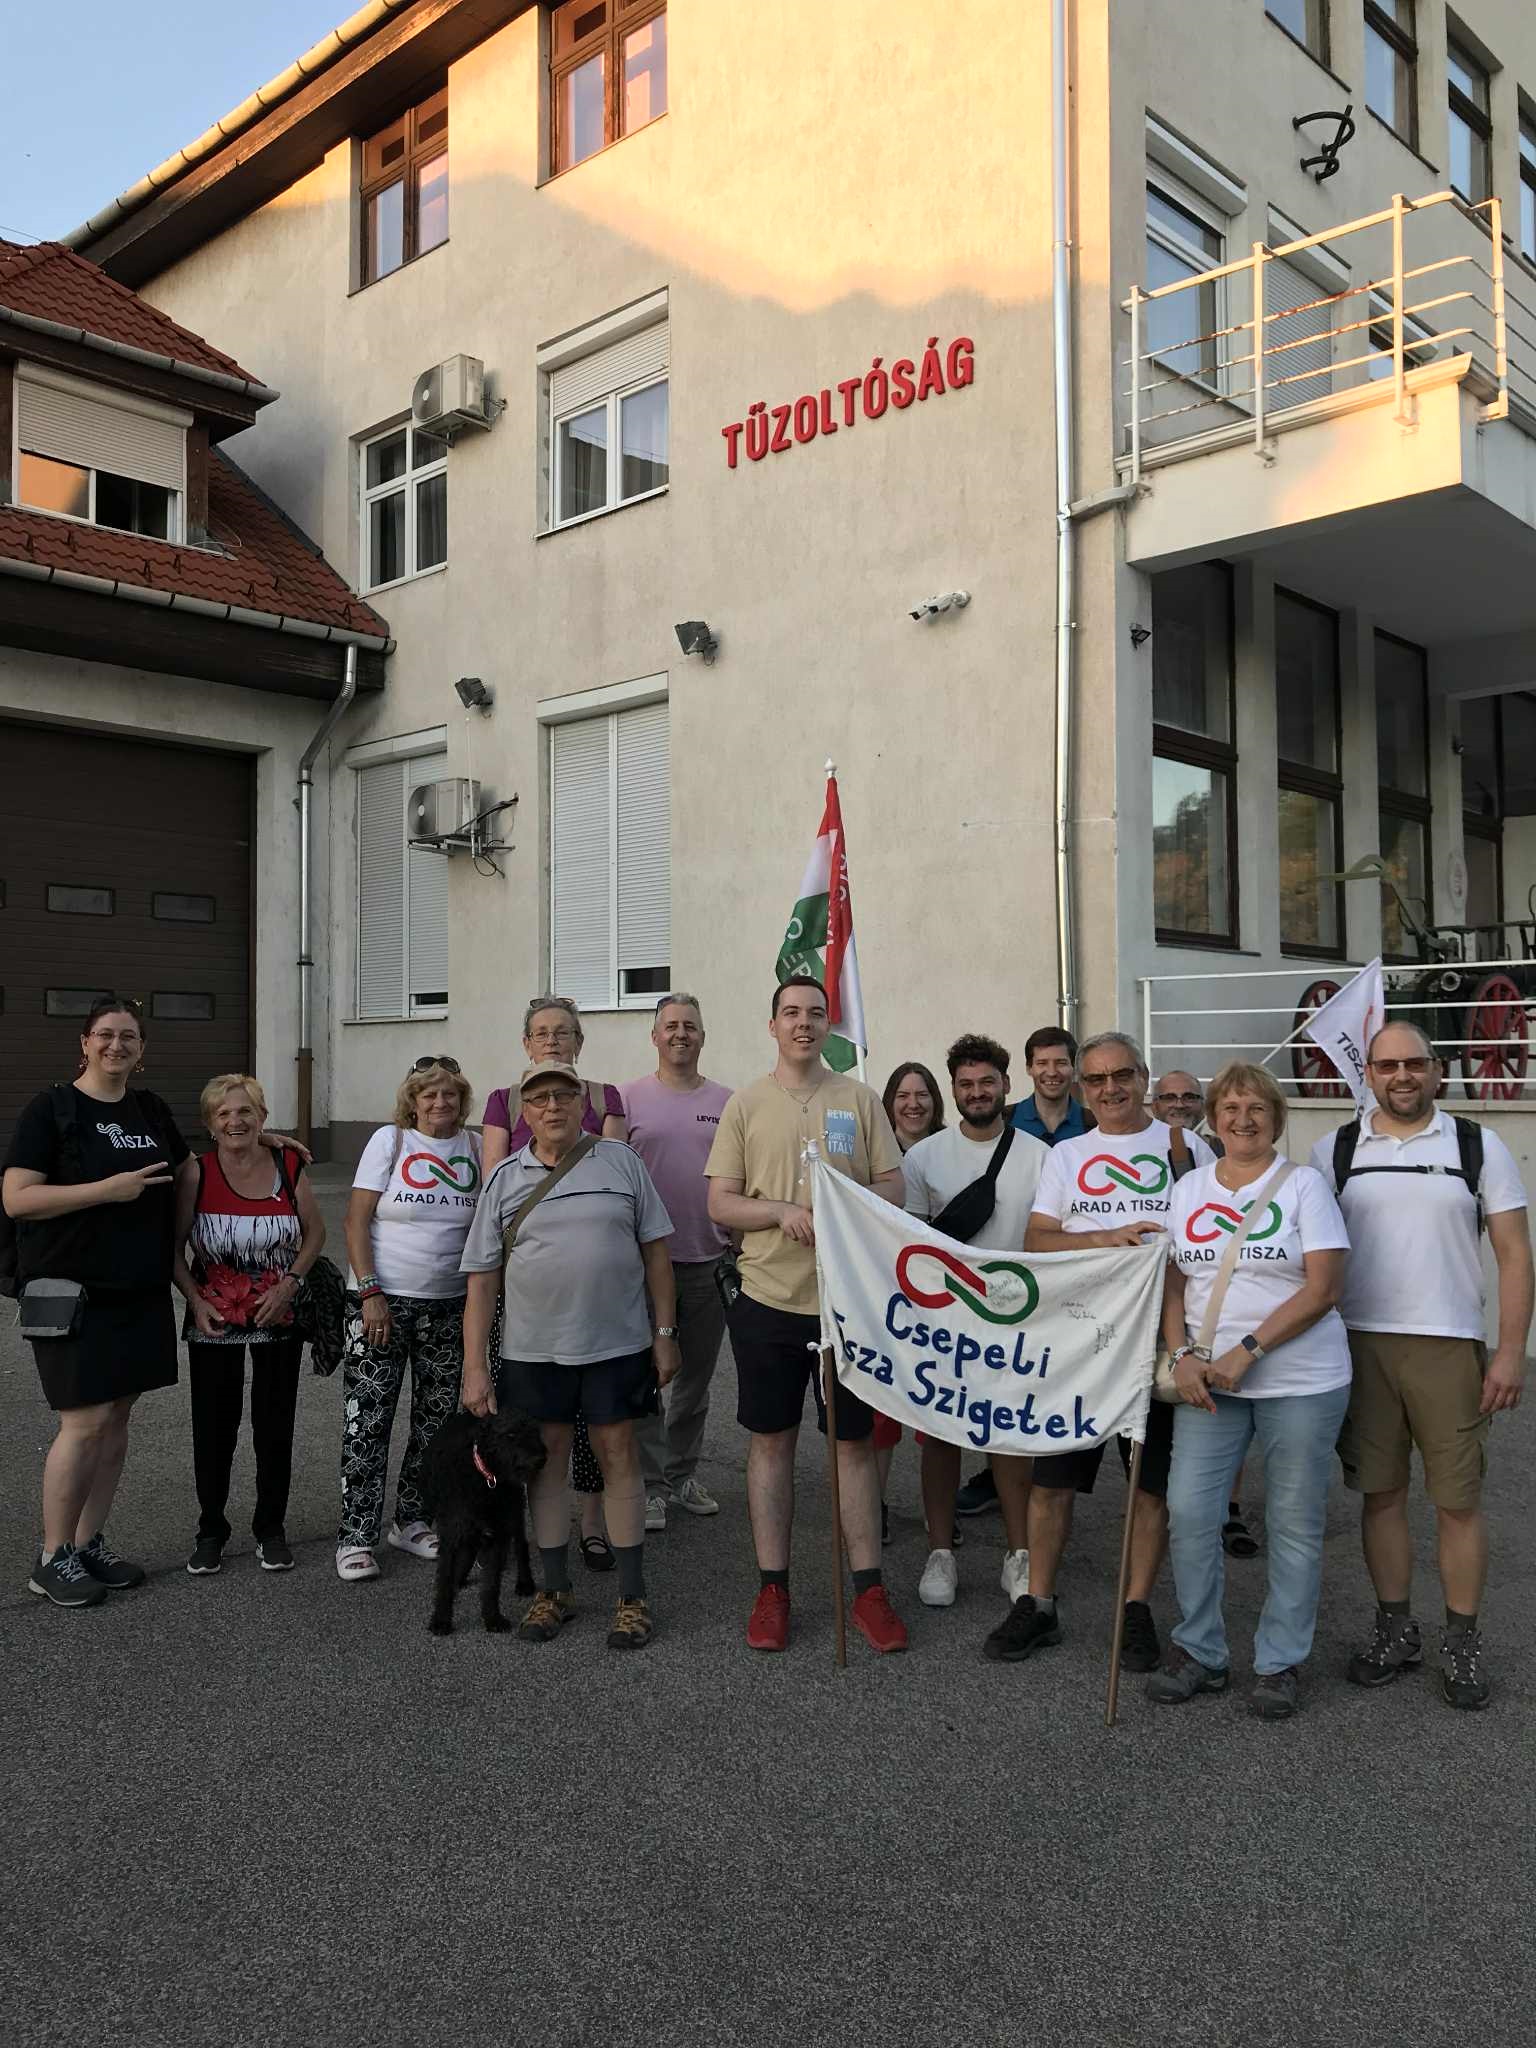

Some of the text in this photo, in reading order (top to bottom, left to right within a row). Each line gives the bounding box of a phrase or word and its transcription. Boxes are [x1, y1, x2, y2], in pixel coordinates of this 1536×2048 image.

[722, 337, 975, 469] TŰZOLTÓSÁG
[394, 1190, 436, 1204] ÁRAD
[440, 1195, 450, 1206] A
[1071, 1199, 1111, 1214] ÁRAD
[1116, 1201, 1126, 1213] A
[1239, 1246, 1288, 1260] TISZA
[886, 1292, 1051, 1378] Csepeli
[908, 1360, 1099, 1446] Szigetek
